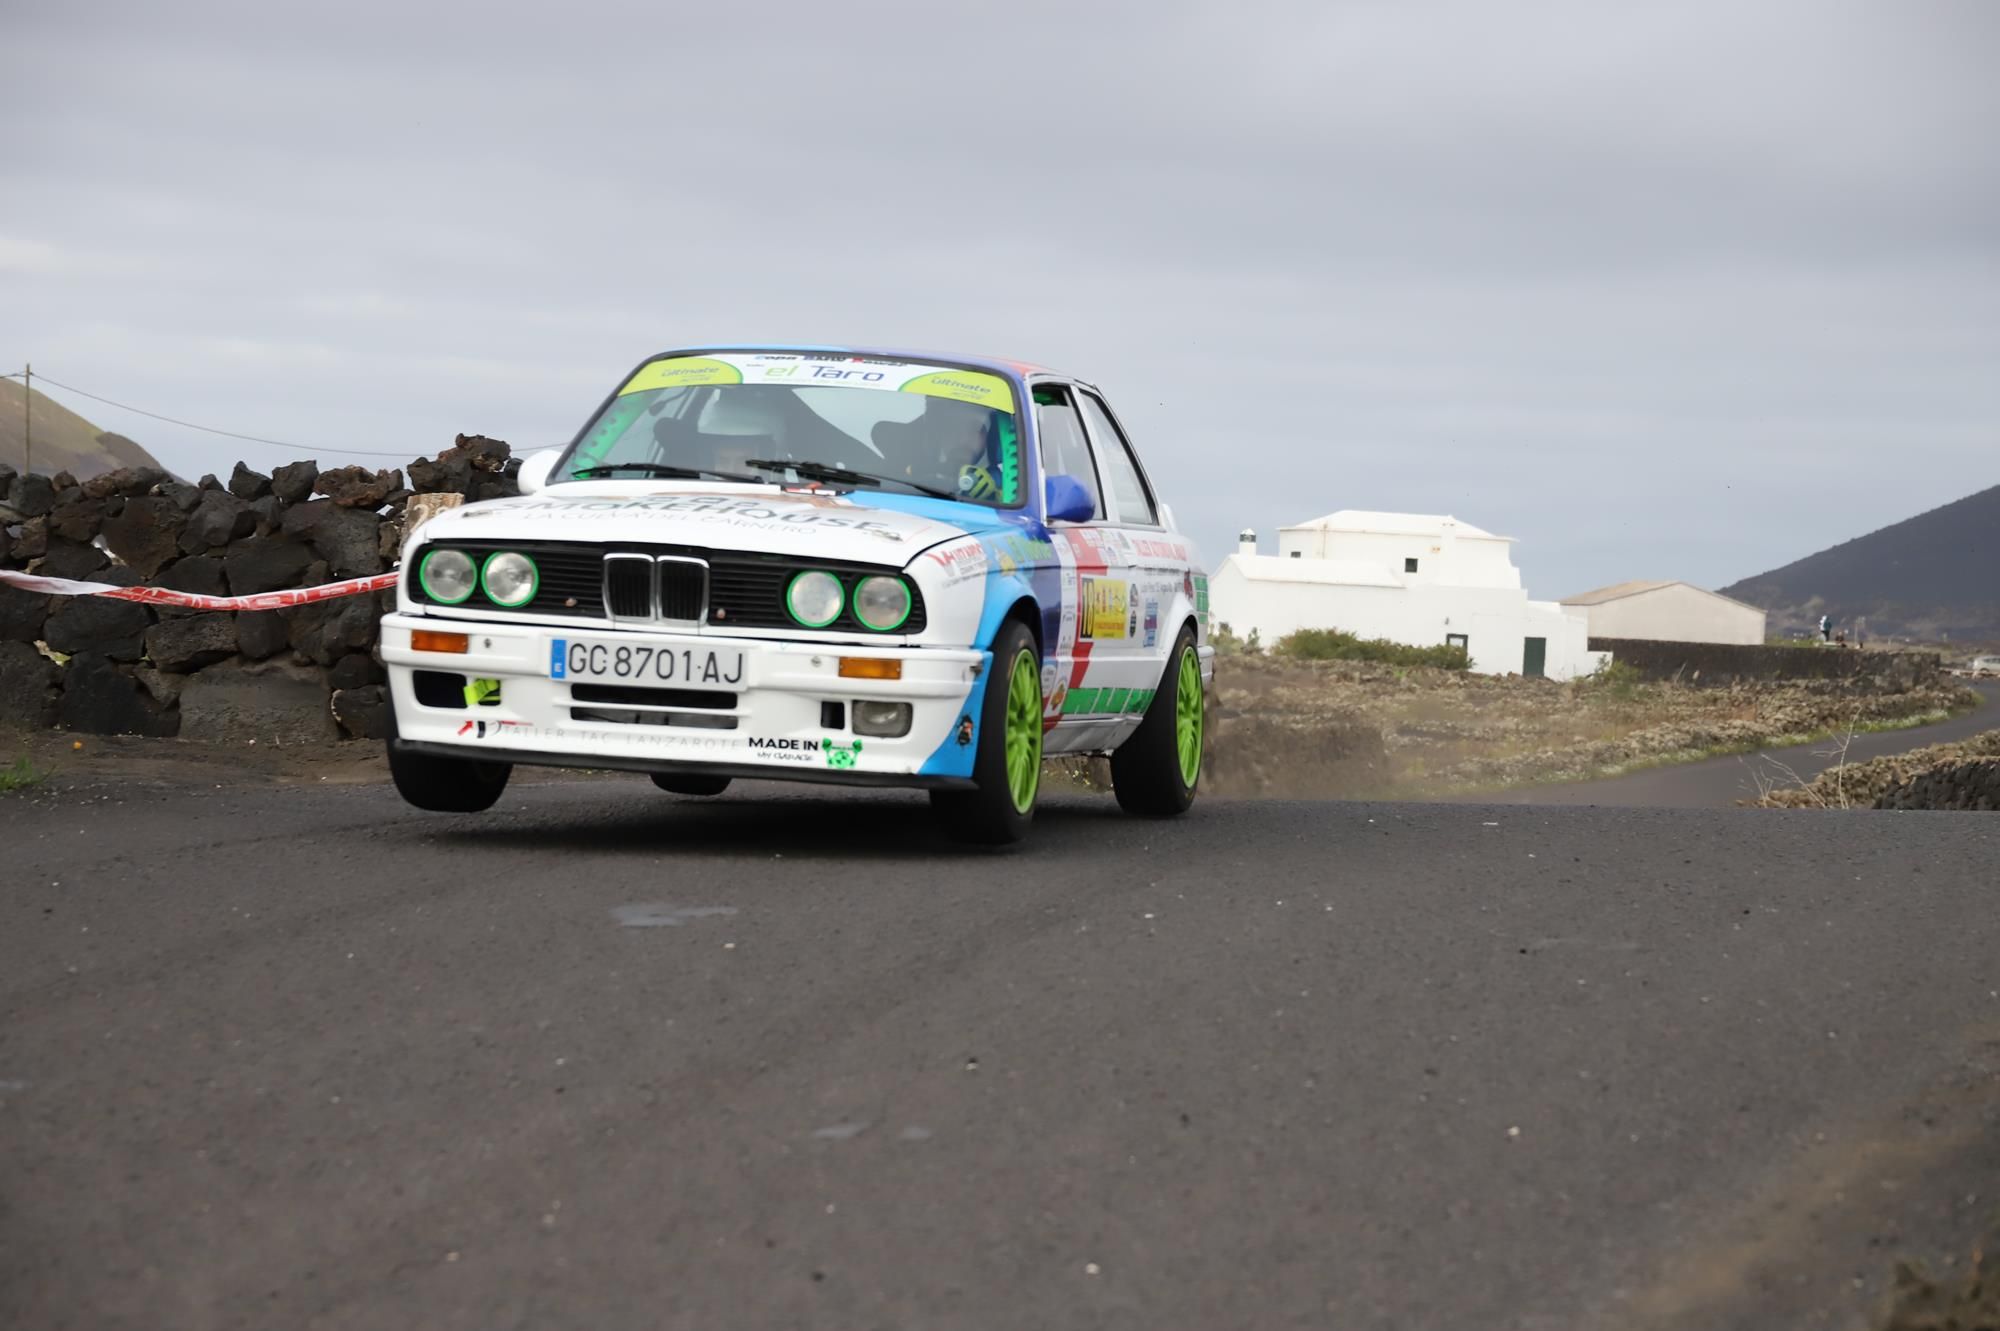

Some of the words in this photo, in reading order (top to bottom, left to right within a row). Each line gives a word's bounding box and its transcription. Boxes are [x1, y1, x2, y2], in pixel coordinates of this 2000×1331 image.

[766, 366, 799, 377] el
[811, 366, 885, 382] Taro
[490, 501, 889, 530] SMOKEHOUSE
[700, 516, 817, 535] CARNERO
[748, 737, 800, 750] MADE
[803, 741, 819, 752] IN
